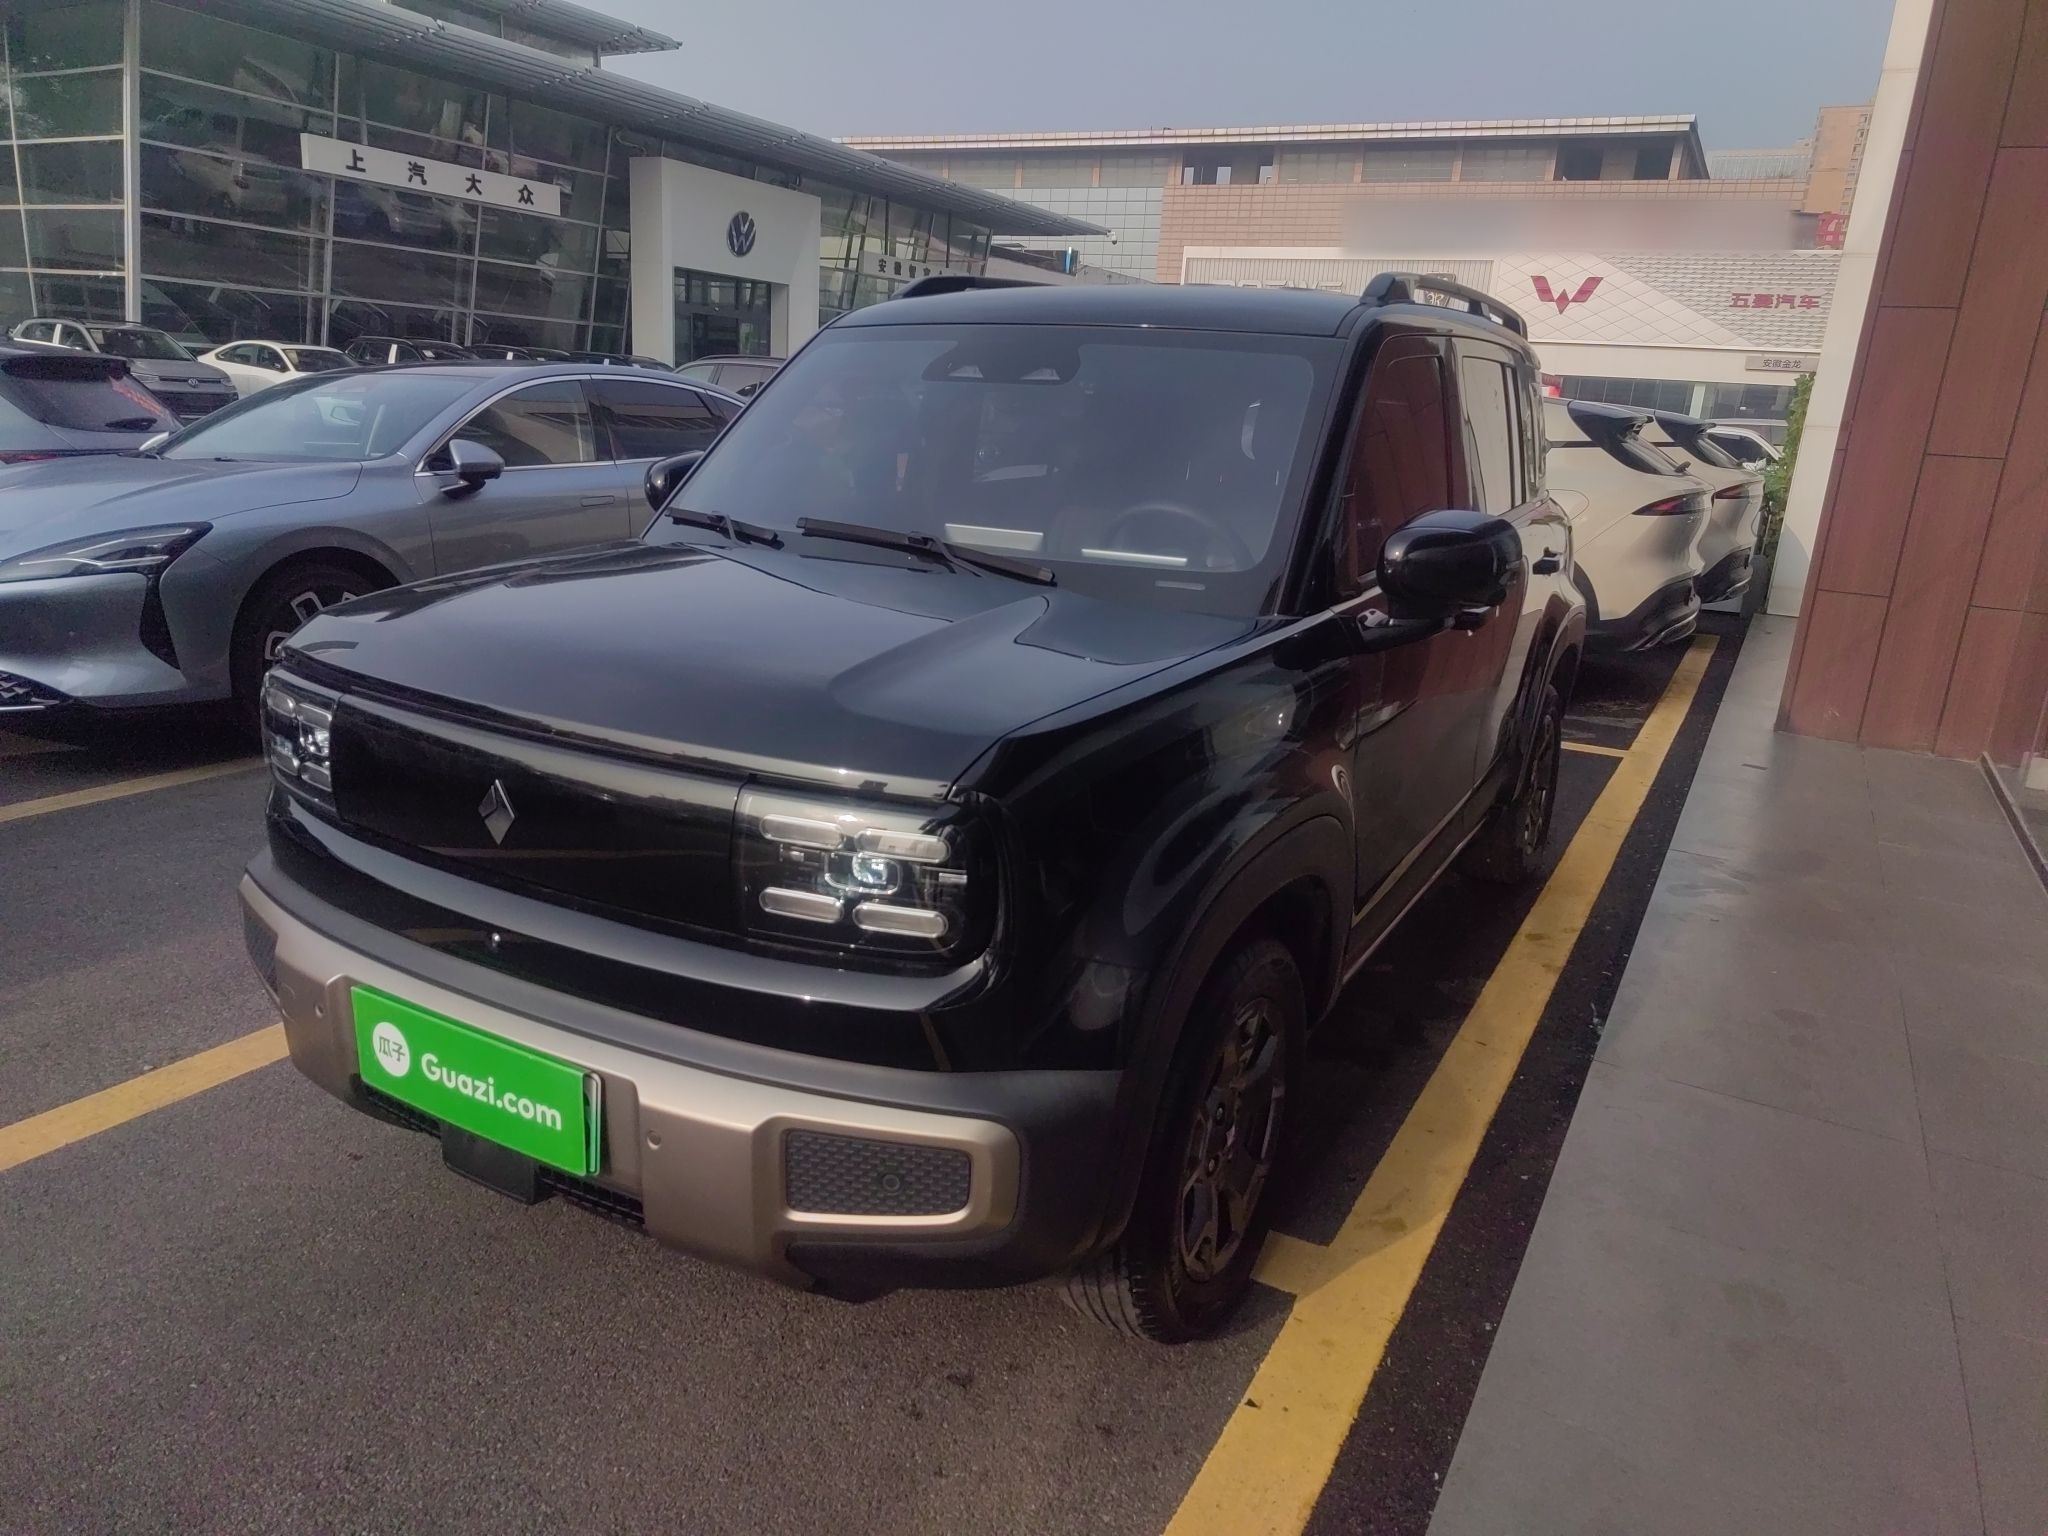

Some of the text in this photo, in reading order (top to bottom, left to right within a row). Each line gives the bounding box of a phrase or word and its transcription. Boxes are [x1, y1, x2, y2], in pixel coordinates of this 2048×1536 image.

[346, 149, 534, 206] 上汽大众
[1729, 293, 1821, 310] 五菱汽车
[379, 1036, 406, 1063] 瓜子
[420, 1052, 563, 1132] Guazi.com
